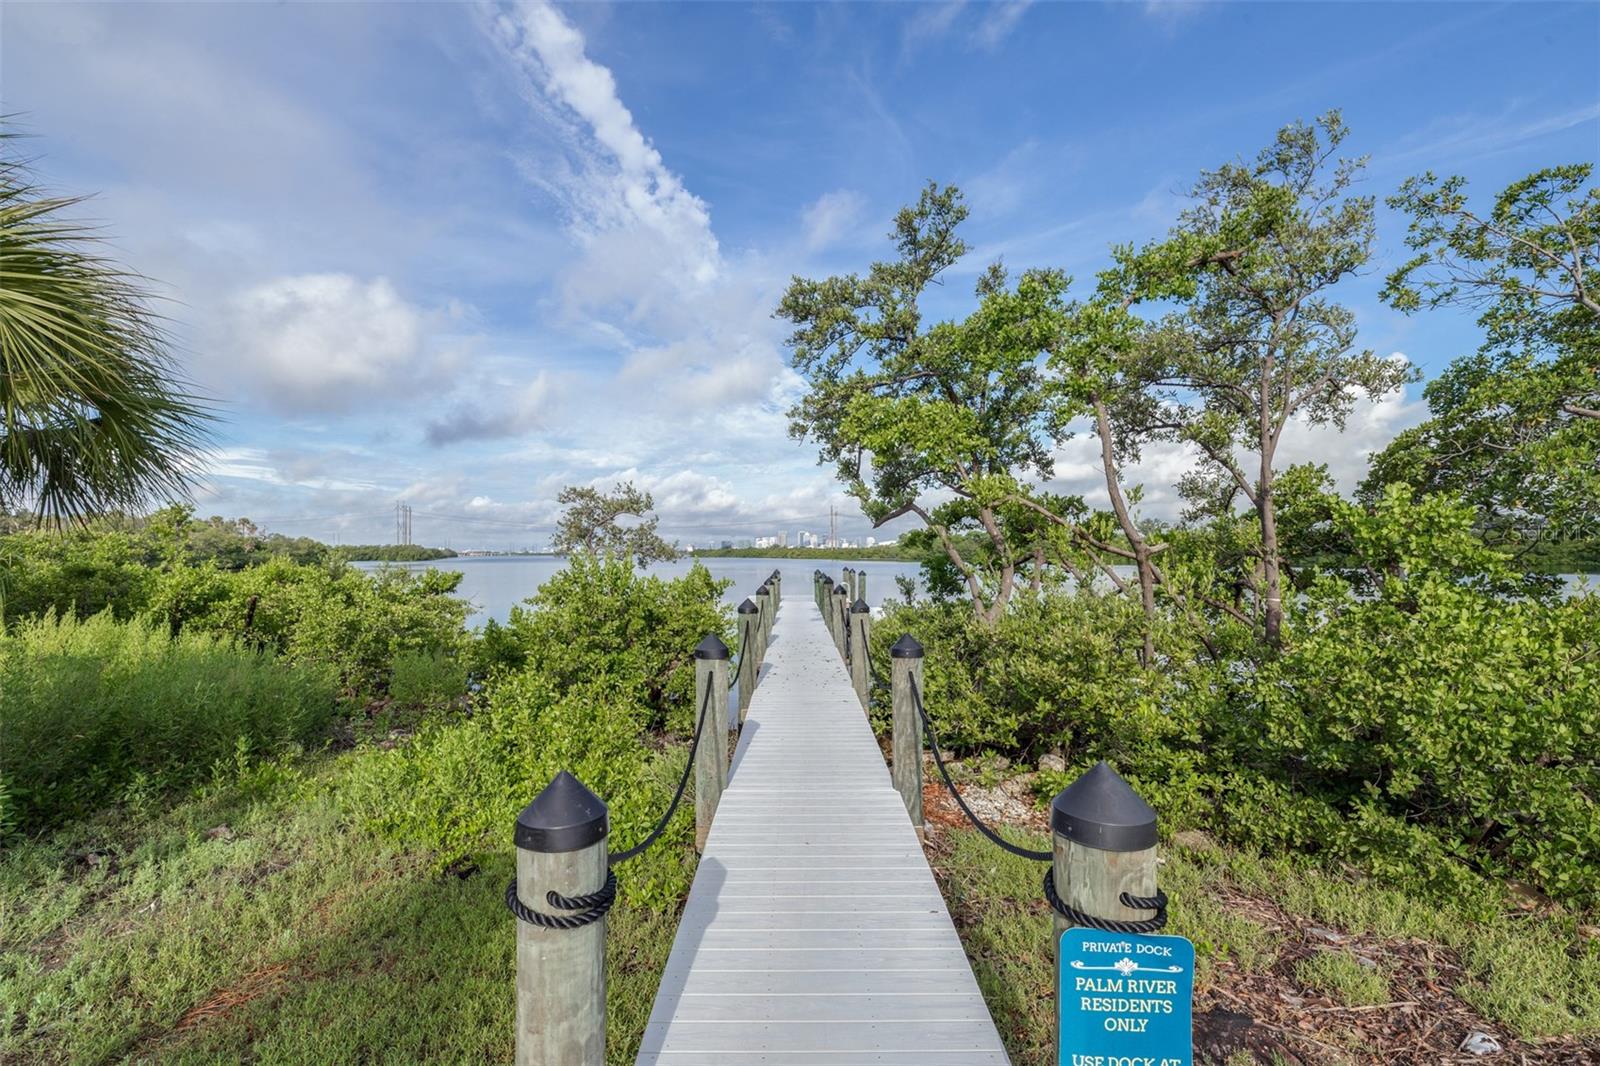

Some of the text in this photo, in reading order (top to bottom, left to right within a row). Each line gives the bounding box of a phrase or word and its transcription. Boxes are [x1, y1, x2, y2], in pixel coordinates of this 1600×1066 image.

[1082, 941, 1172, 957] PRIVATE DOCK
[1075, 977, 1177, 994] PALM RIVER
[1081, 997, 1173, 1014] RESIDENTS
[1104, 1017, 1149, 1032] ONLY
[1071, 1054, 1104, 1066] USE
[1108, 1057, 1155, 1066] DOCK
